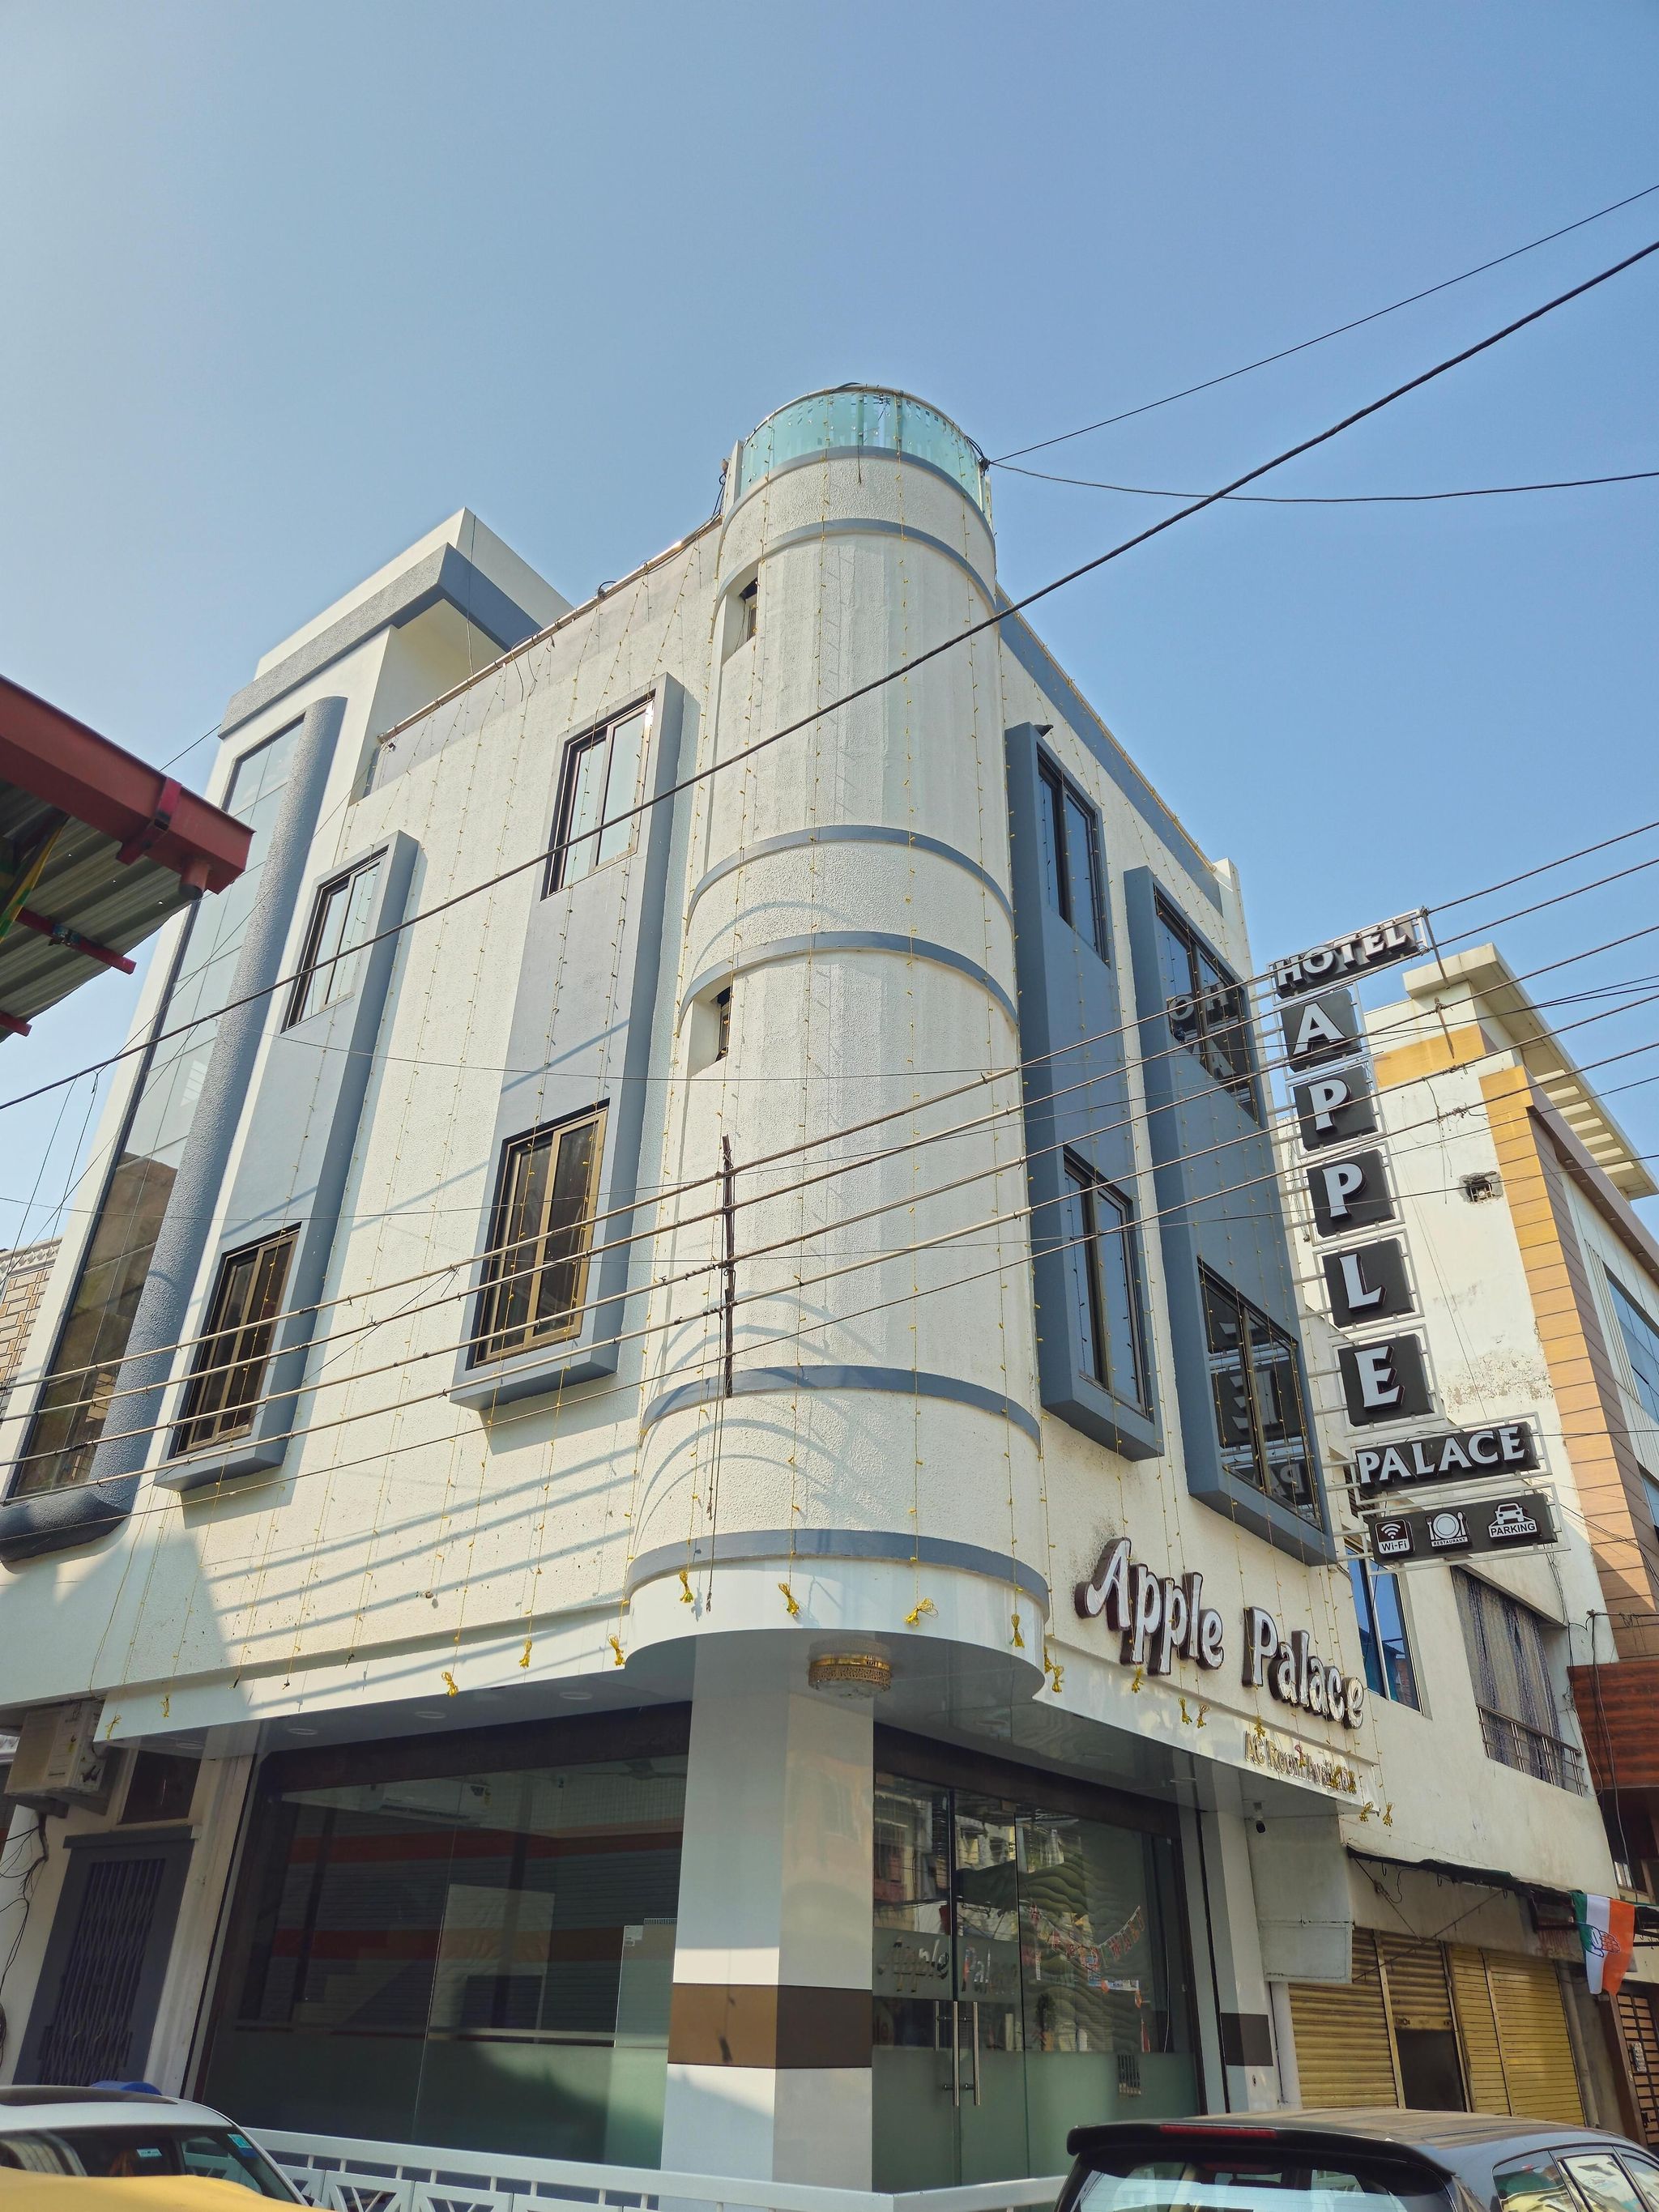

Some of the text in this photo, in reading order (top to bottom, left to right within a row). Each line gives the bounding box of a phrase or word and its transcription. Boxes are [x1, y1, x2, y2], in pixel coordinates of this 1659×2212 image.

[1274, 920, 1409, 987] HOTEL
[1292, 1002, 1405, 1411] APPLE
[1358, 1426, 1526, 1485] PALACE
[1381, 1523, 1536, 1551] Wi-Fi RESTAURANT PARKING
[1075, 1537, 1364, 1729] Apple Palace
